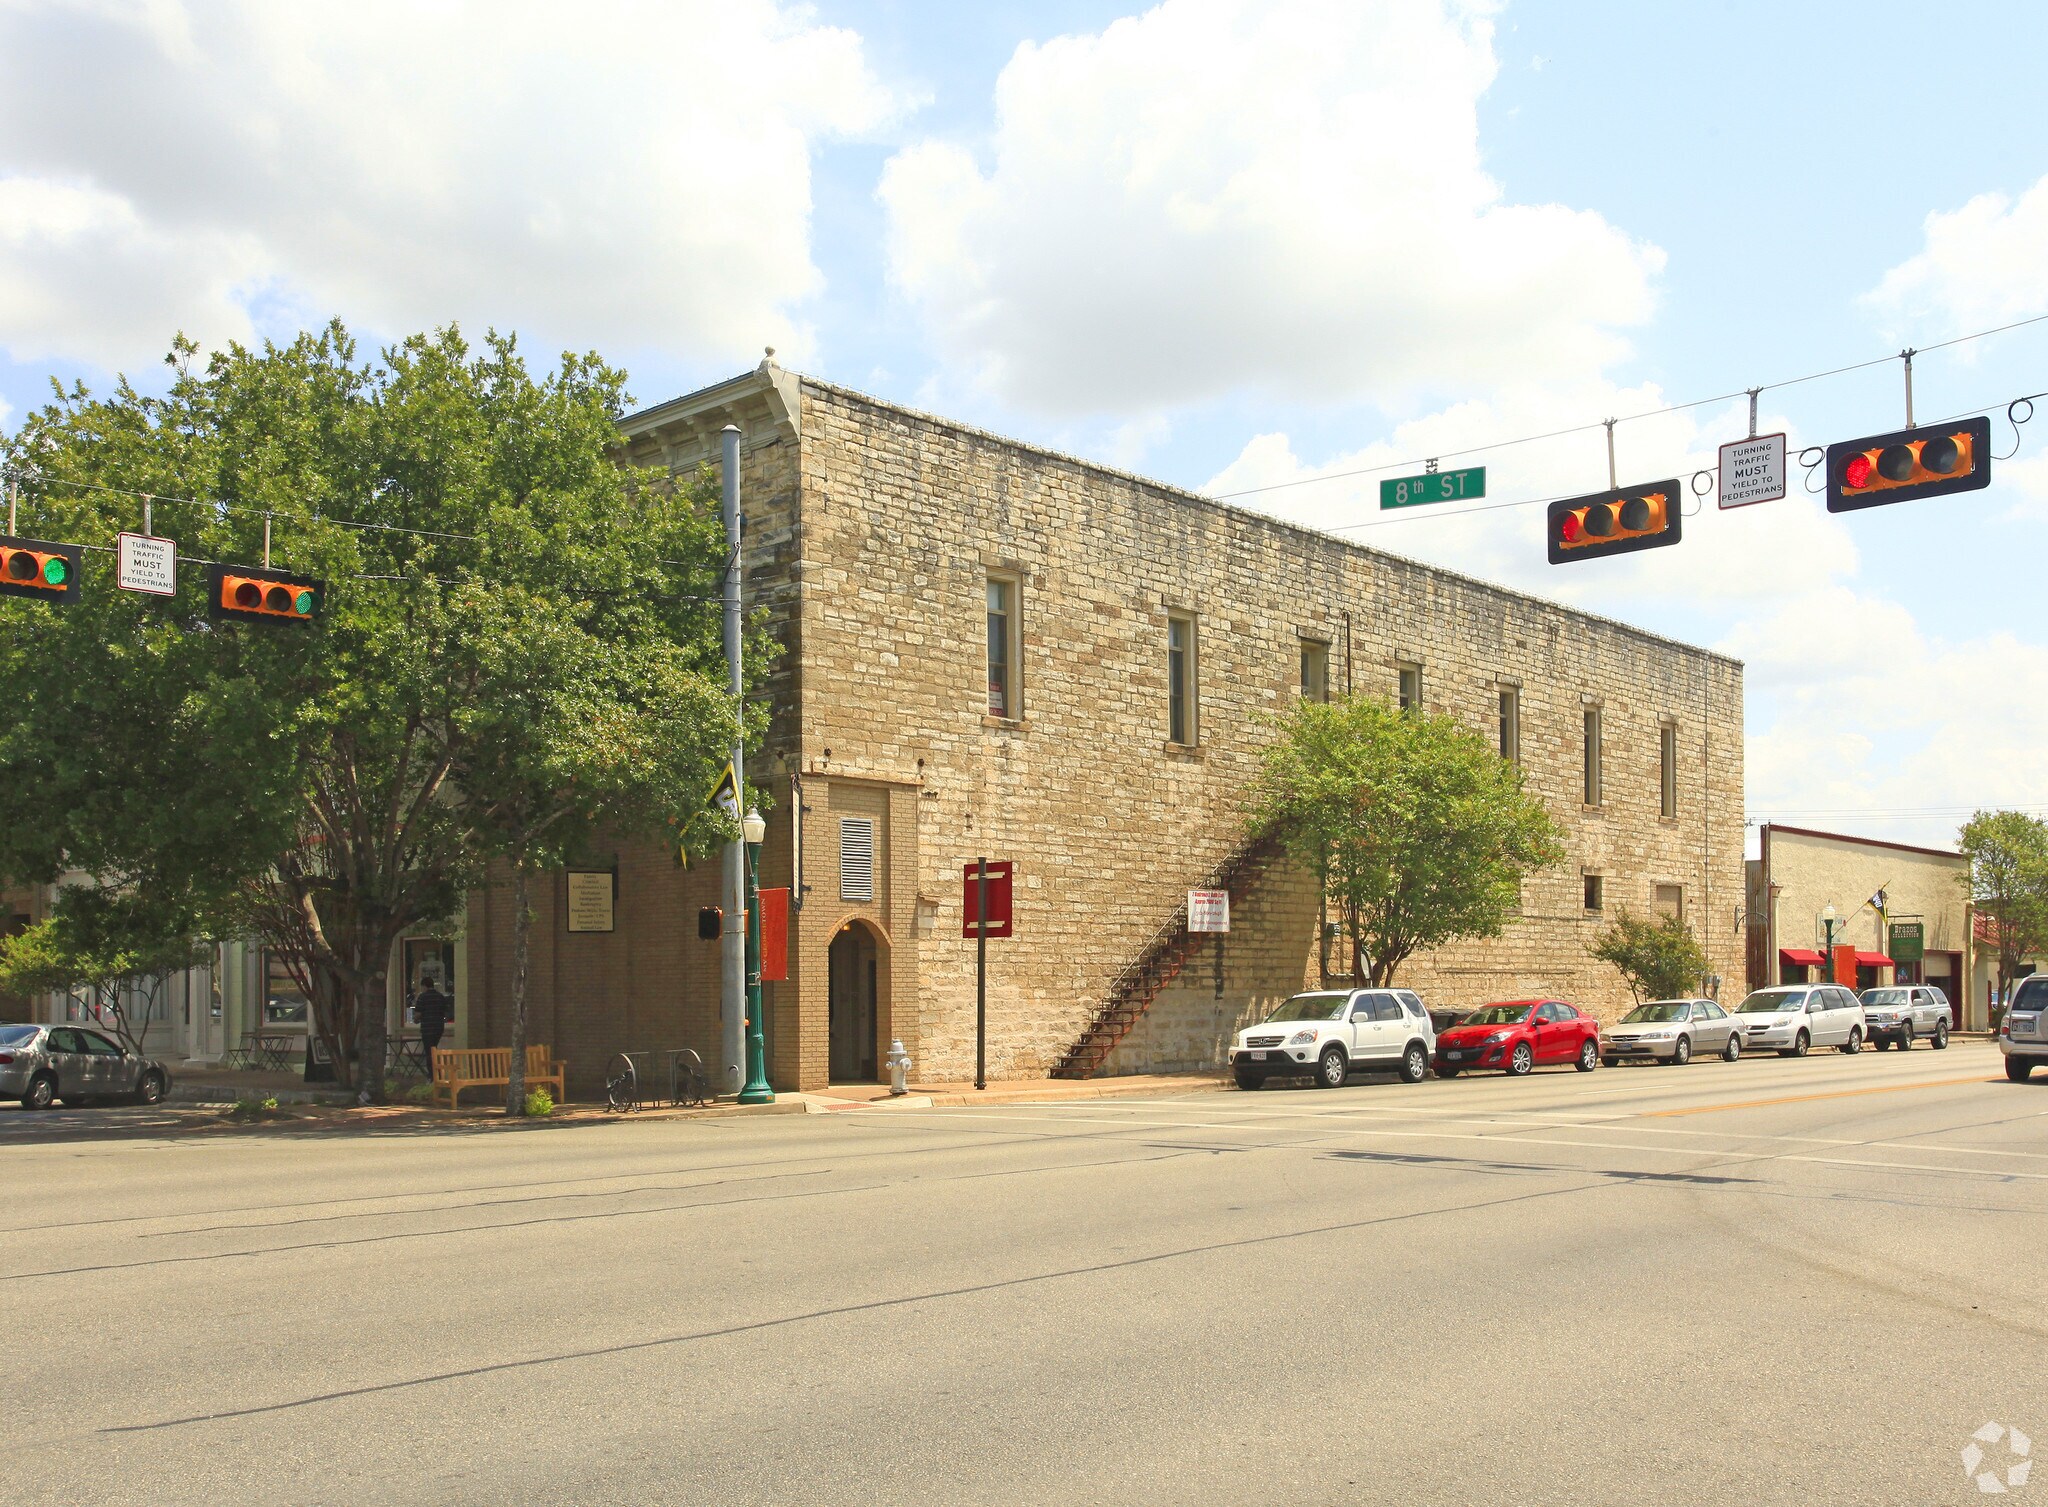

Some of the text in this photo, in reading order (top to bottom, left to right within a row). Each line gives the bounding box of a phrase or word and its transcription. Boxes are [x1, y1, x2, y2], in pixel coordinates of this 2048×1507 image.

[1732, 443, 1772, 457] TURNING
[1733, 453, 1771, 467] TRAFFIC
[1735, 464, 1768, 479] MUST
[1395, 472, 1468, 504] 8th ST
[1731, 476, 1773, 489] YIELD TO
[1721, 484, 1782, 501] PEDESTRIANS
[132, 541, 165, 552] TURNING
[132, 550, 164, 560] TRAFFIC
[133, 559, 162, 570] MUST
[130, 569, 153, 577] YIELD
[122, 576, 173, 589] PEDESTRIANS
[1894, 925, 1918, 934] Brazos
